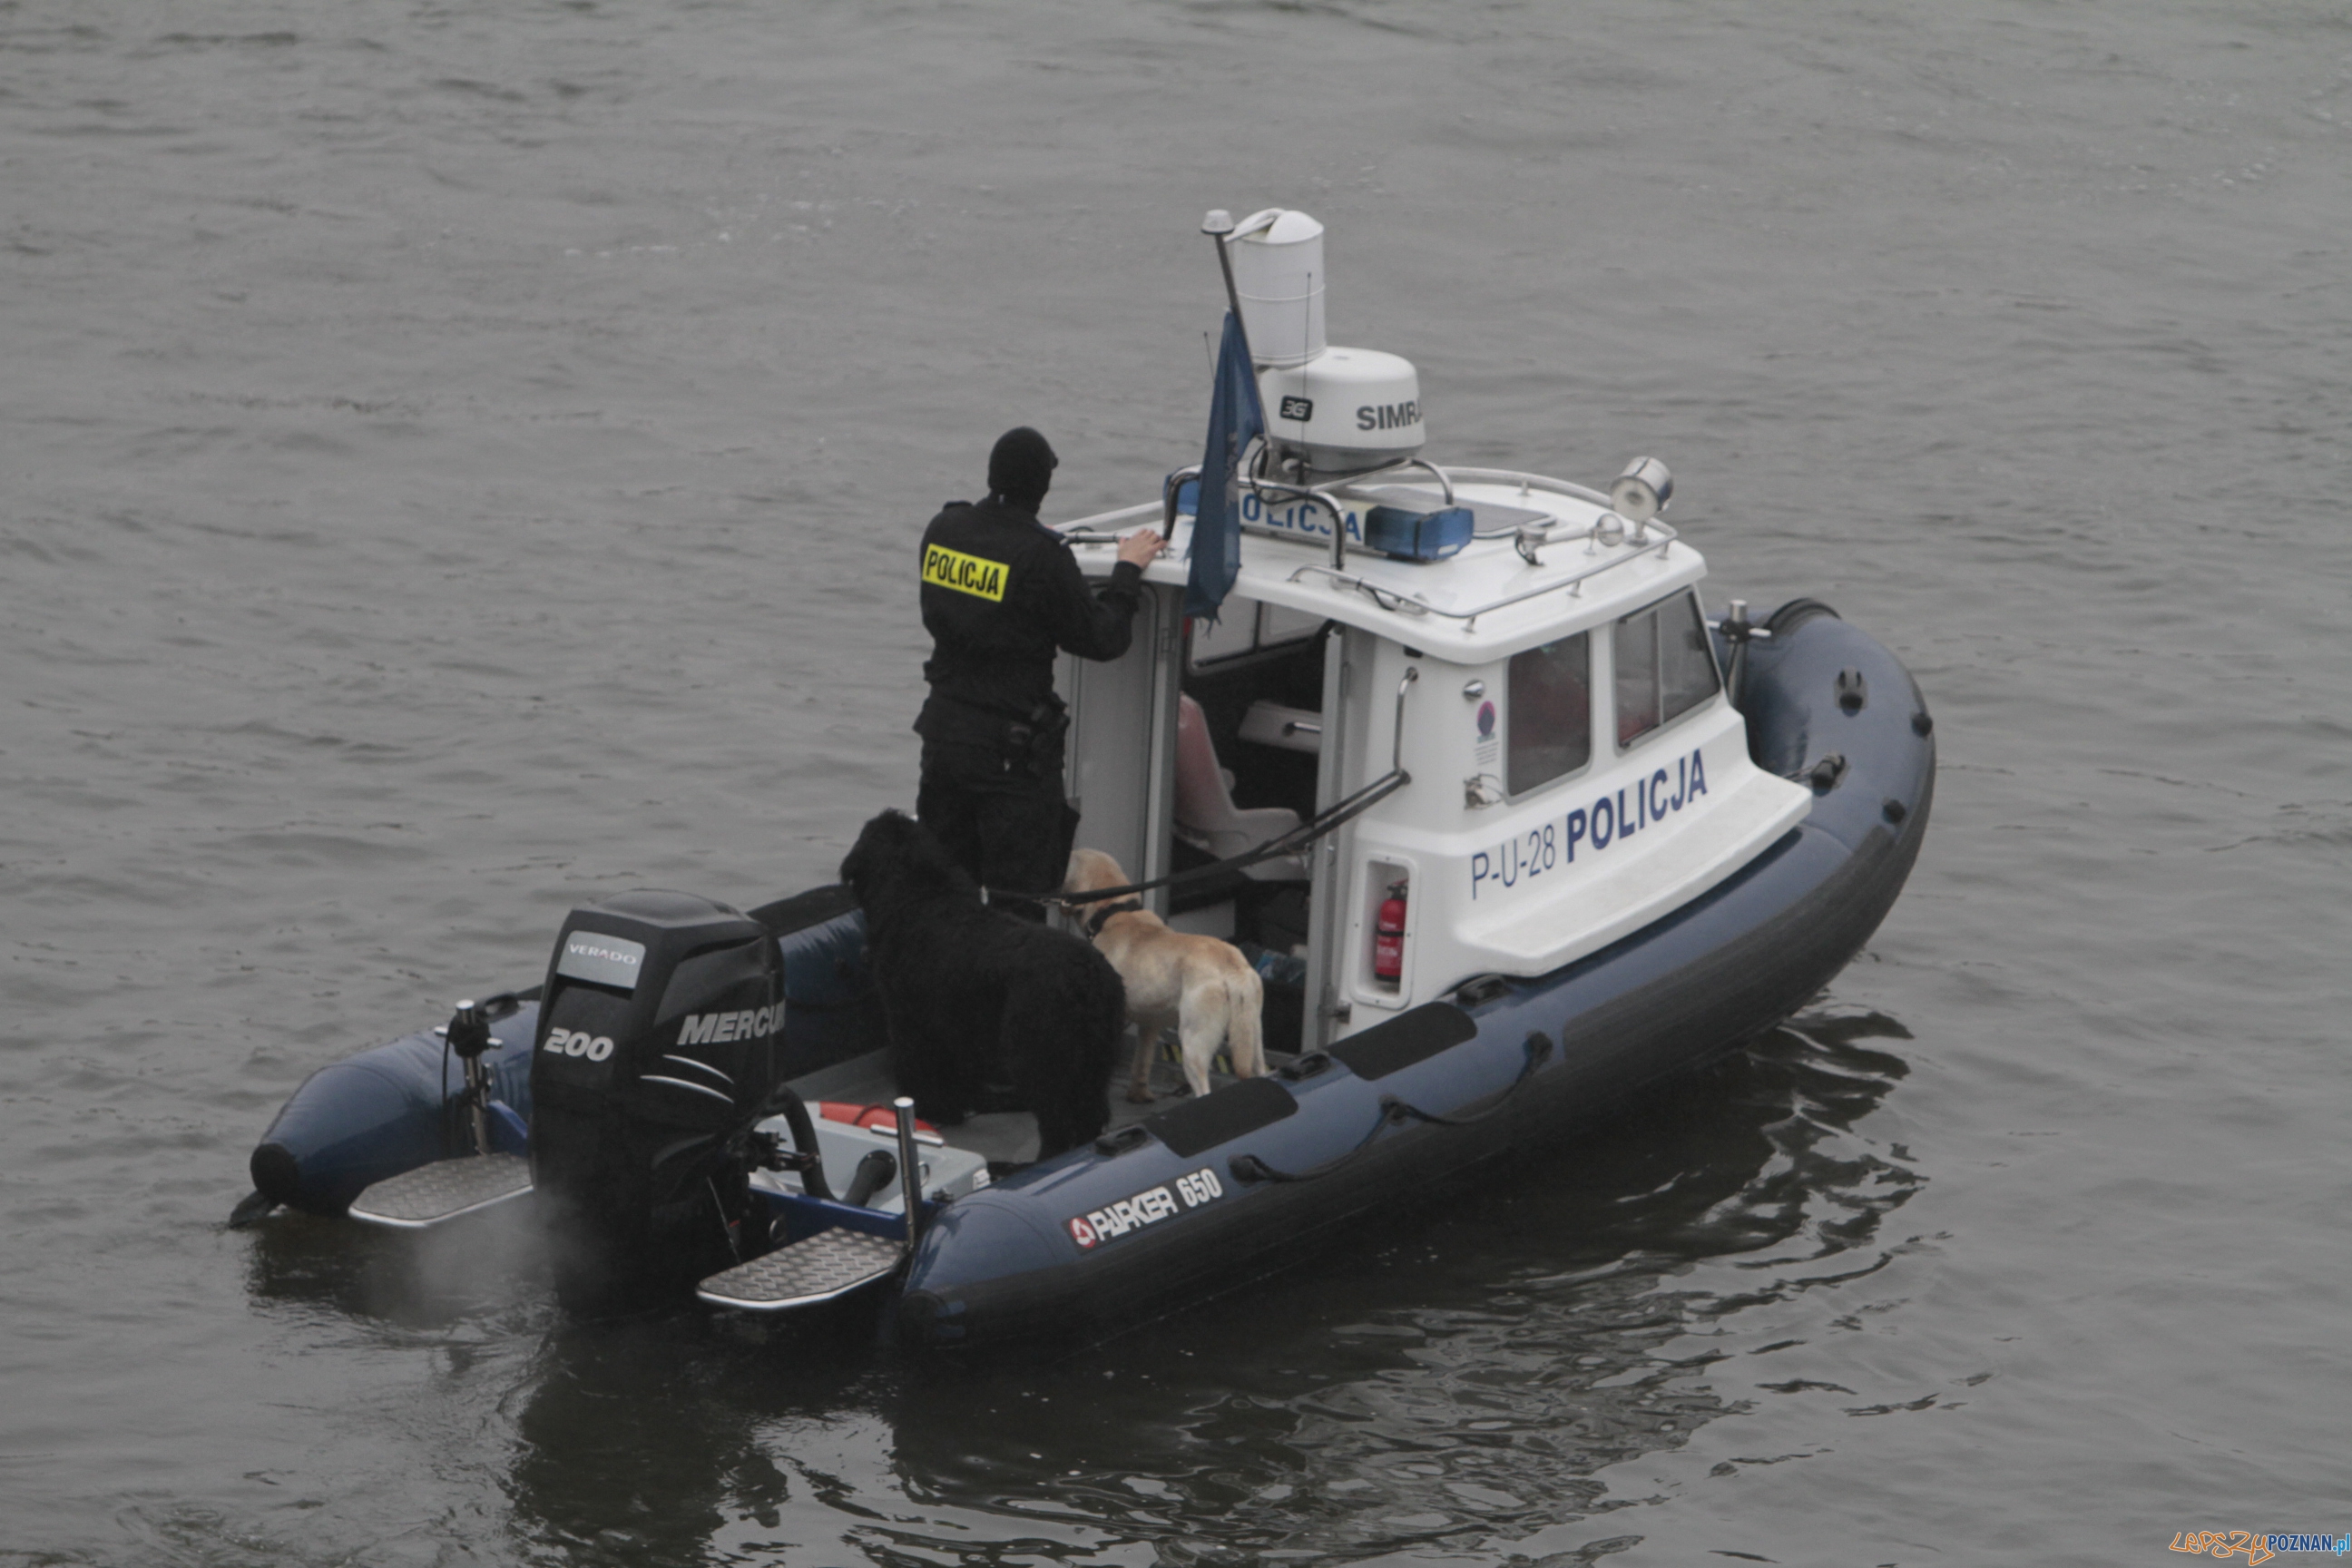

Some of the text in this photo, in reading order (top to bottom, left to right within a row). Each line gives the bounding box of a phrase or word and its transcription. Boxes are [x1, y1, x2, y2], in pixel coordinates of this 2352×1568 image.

[1281, 399, 1309, 419] 3G
[1242, 493, 1361, 541] OLICA
[926, 550, 999, 595] POLICJA
[1472, 749, 1708, 900] P-U-28 POLICJA
[569, 943, 637, 965] VERADO
[544, 1027, 614, 1062] 200
[1087, 1168, 1223, 1241] PARKER 650
